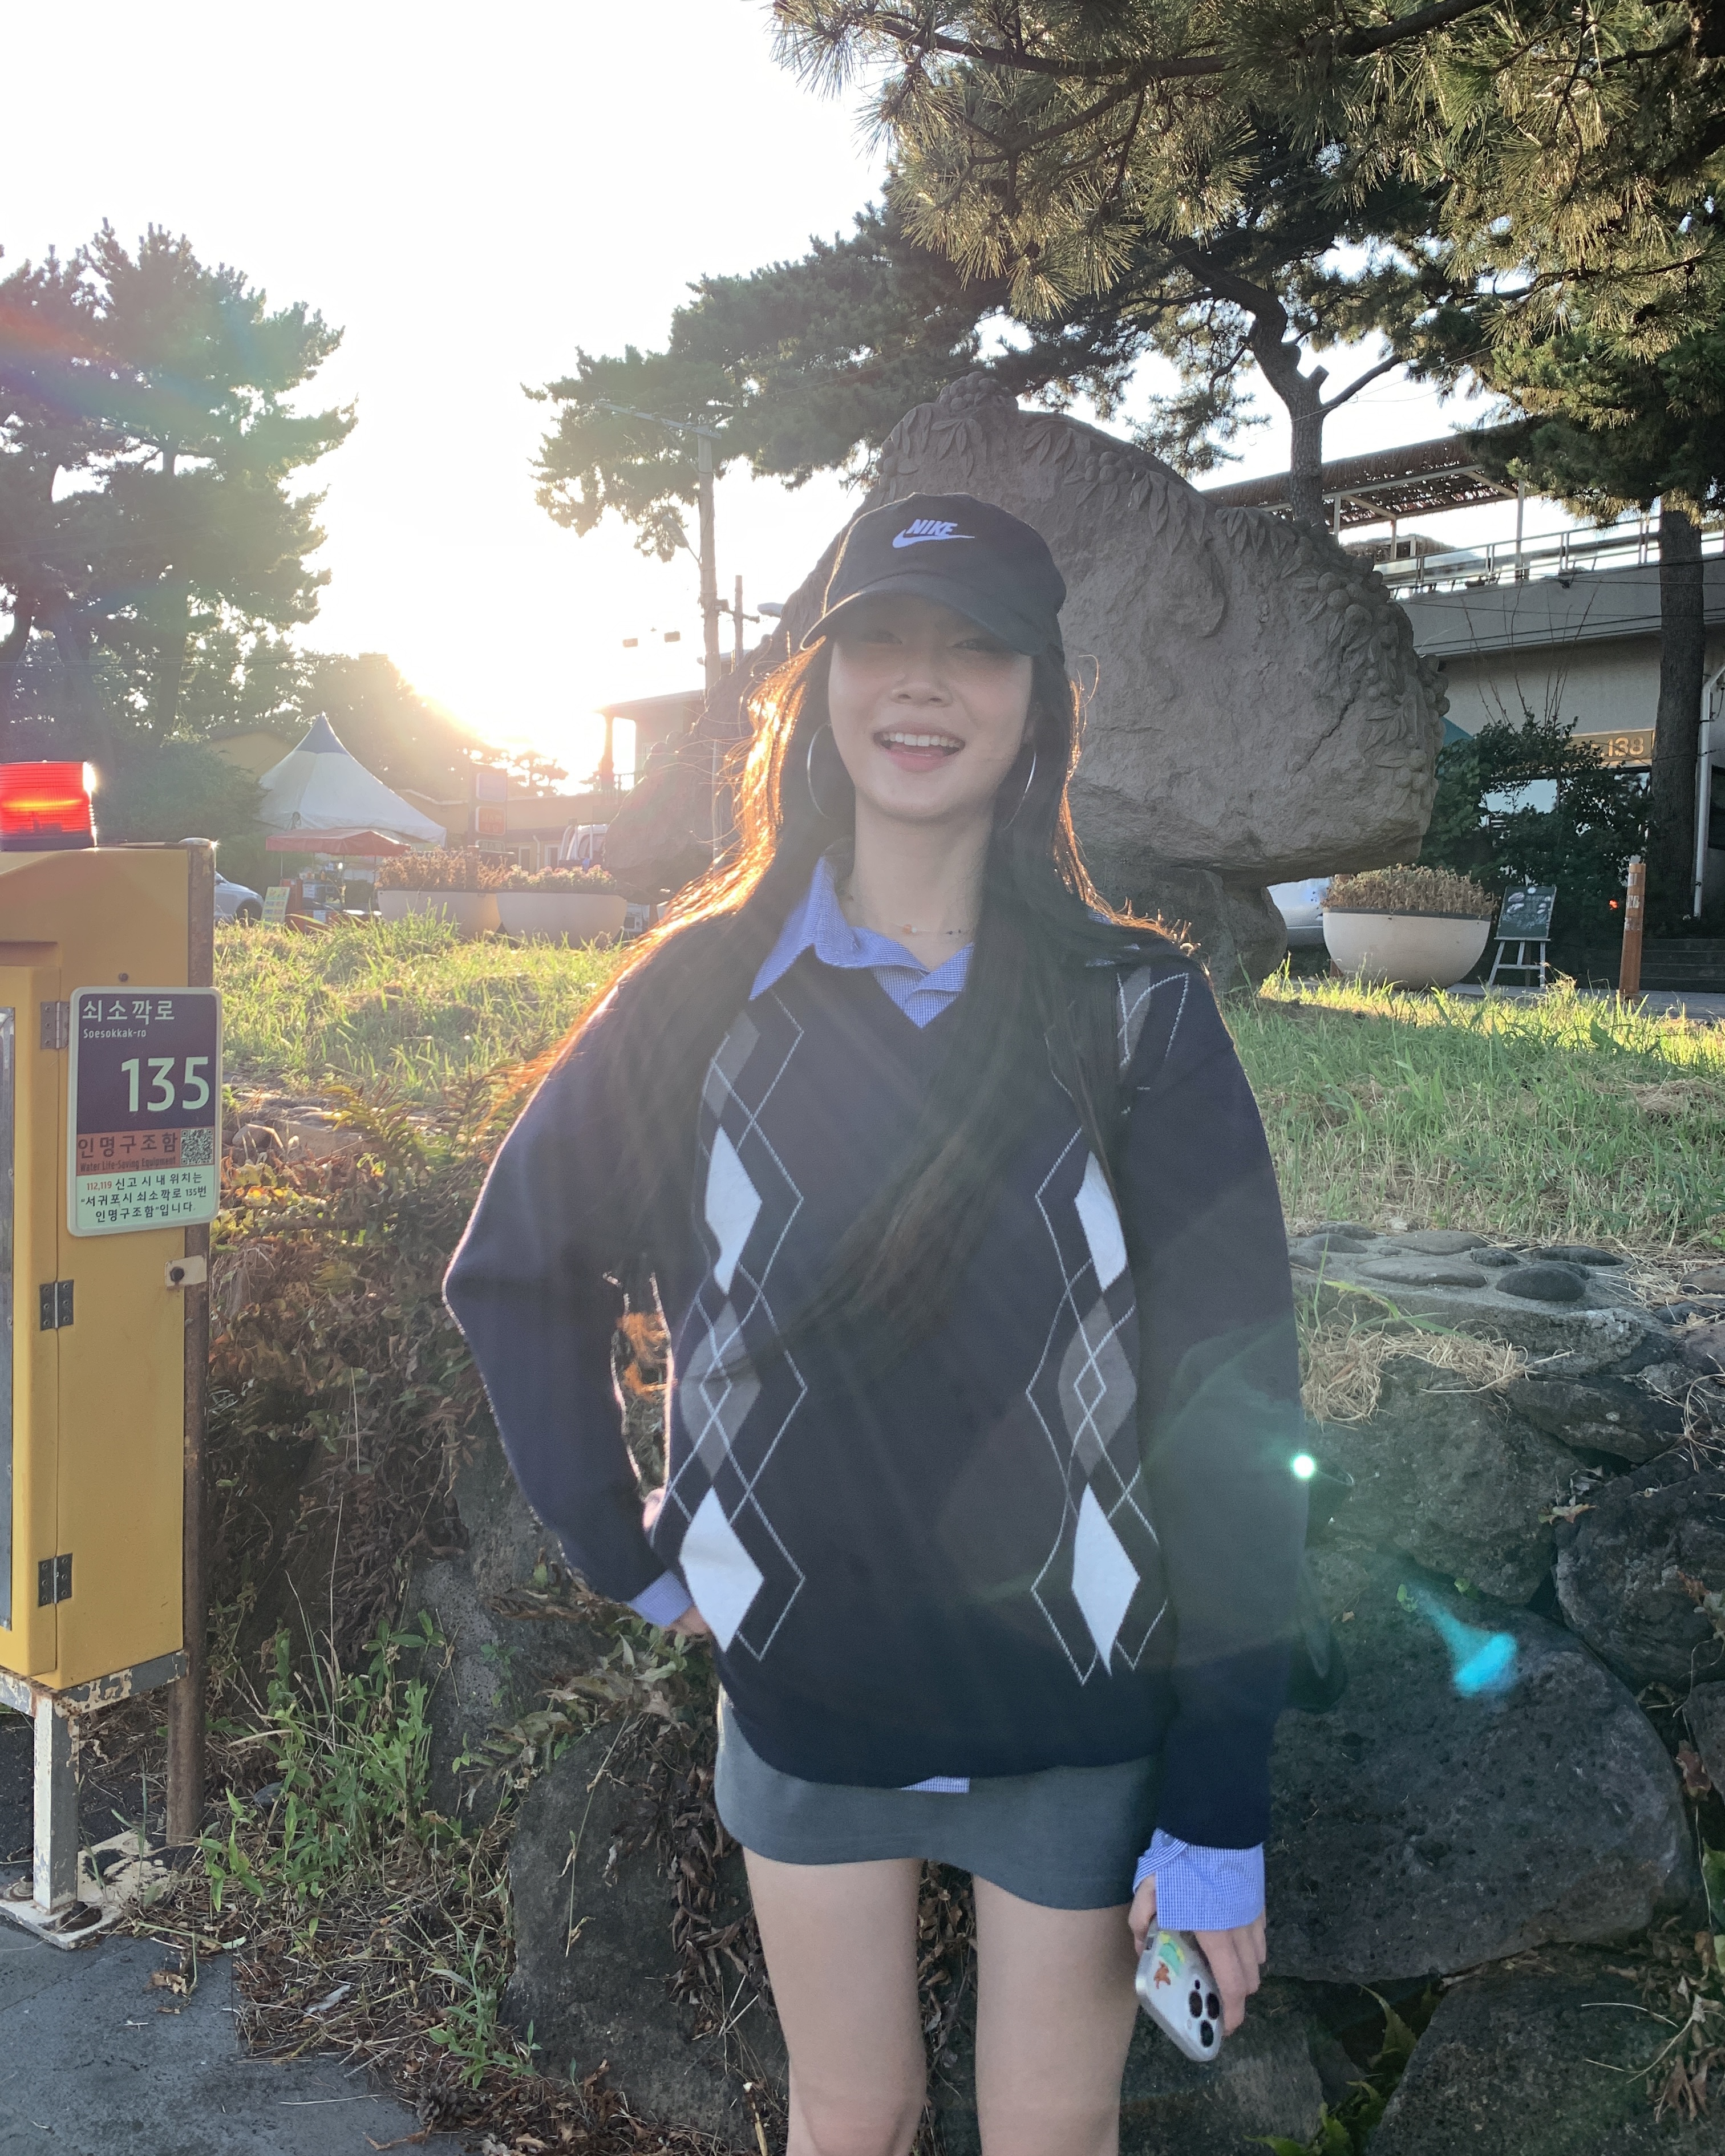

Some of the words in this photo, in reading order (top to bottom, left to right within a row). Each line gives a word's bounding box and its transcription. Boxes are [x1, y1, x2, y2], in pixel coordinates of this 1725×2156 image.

[905, 519, 958, 536] NIKE
[82, 1000, 175, 1025] 쇠소깍로
[83, 1028, 147, 1039] Soesokkak-ro
[121, 1056, 210, 1112] 135
[78, 1132, 179, 1159] 인명구조함
[80, 1162, 101, 1172] Water
[102, 1158, 139, 1170] Life-Saving
[141, 1156, 176, 1168] Equipment
[87, 1181, 112, 1191] 112,119
[115, 1178, 137, 1190] 신고
[142, 1176, 151, 1187] 시
[156, 1174, 165, 1186] 내
[169, 1172, 203, 1185] 위치는
[137, 1188, 182, 1202] 쇠소깍로
[185, 1186, 207, 1198] 135번
